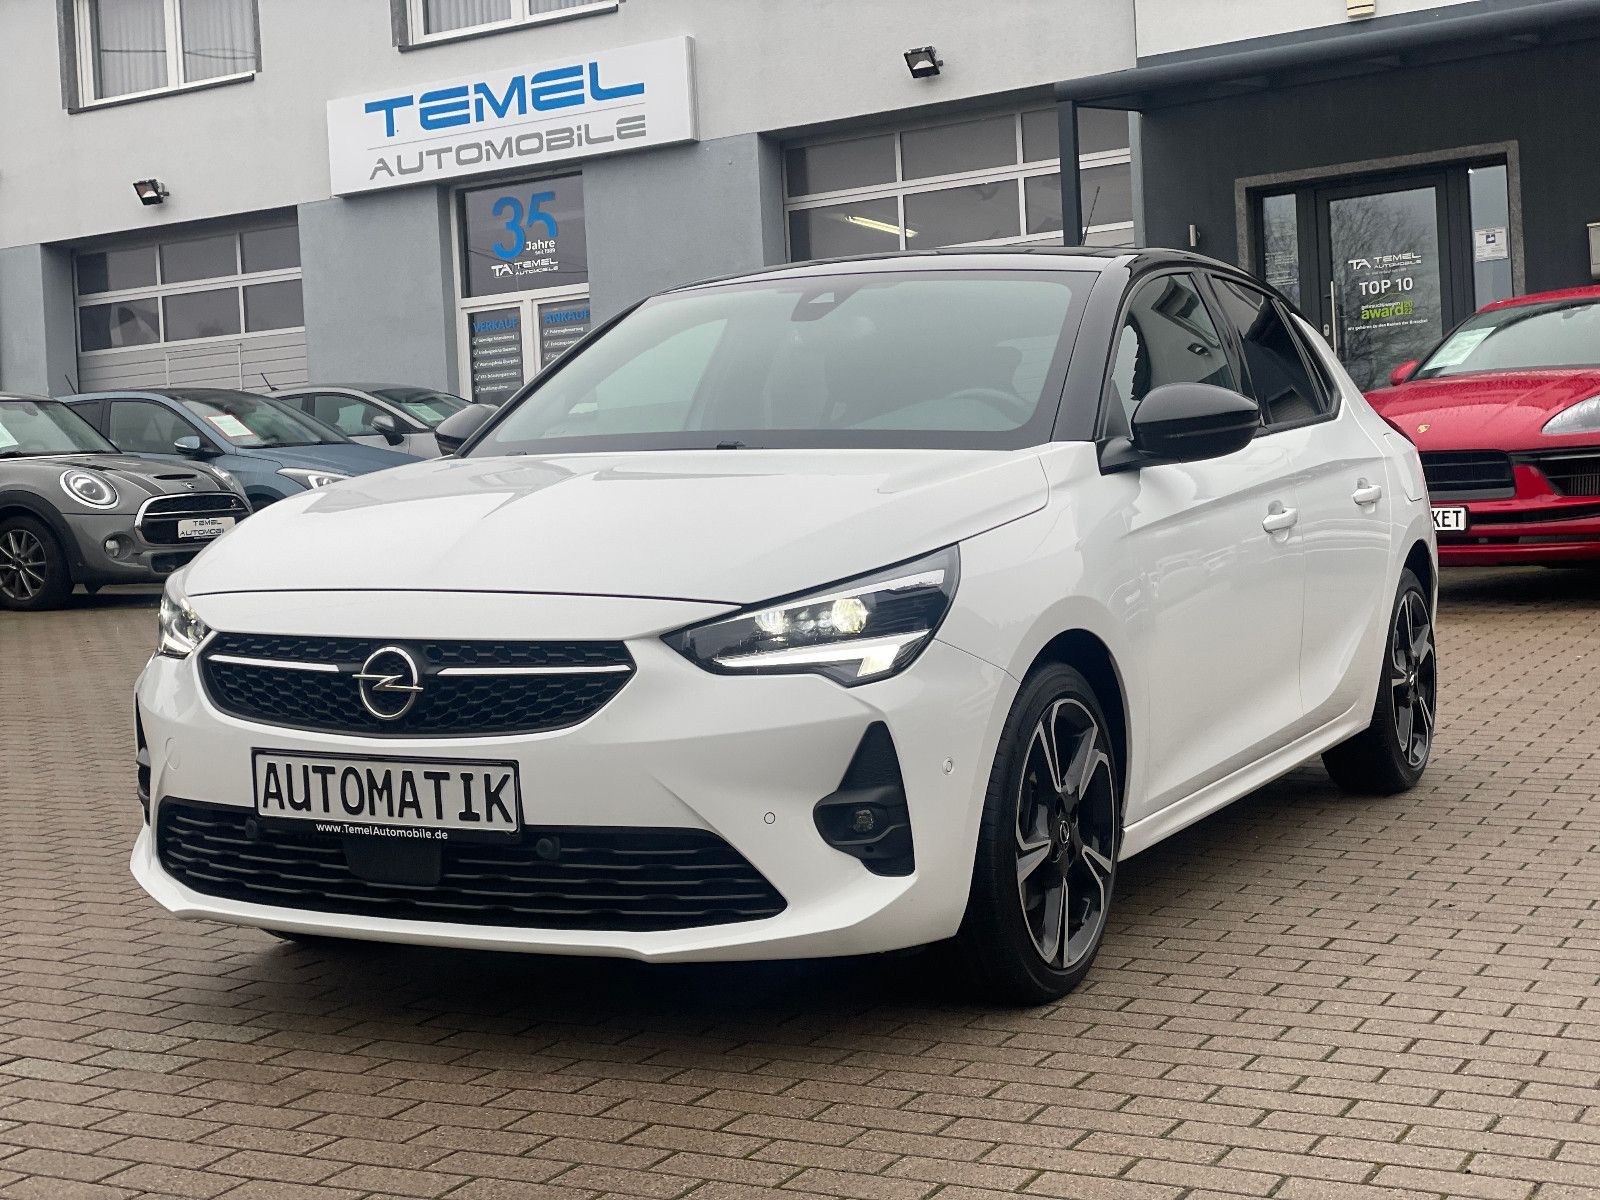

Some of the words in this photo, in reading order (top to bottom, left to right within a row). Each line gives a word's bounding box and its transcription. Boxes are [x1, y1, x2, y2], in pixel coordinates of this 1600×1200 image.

[364, 61, 645, 137] TEMEL
[491, 191, 558, 260] 35
[526, 239, 556, 251] Jahre
[514, 257, 559, 269] TEMEL
[1347, 258, 1372, 270] TA
[1373, 252, 1422, 264] TEMEL
[491, 263, 514, 277] TA
[1359, 279, 1392, 296] TOP
[1395, 277, 1414, 292] 10
[1361, 303, 1404, 320] award
[193, 519, 223, 527] TEMEL
[1431, 510, 1462, 528] KET
[179, 528, 225, 537] AUTOMOBI
[262, 762, 514, 824] AUTOMATIK
[315, 823, 449, 841] www.TemelAutomobile.de
